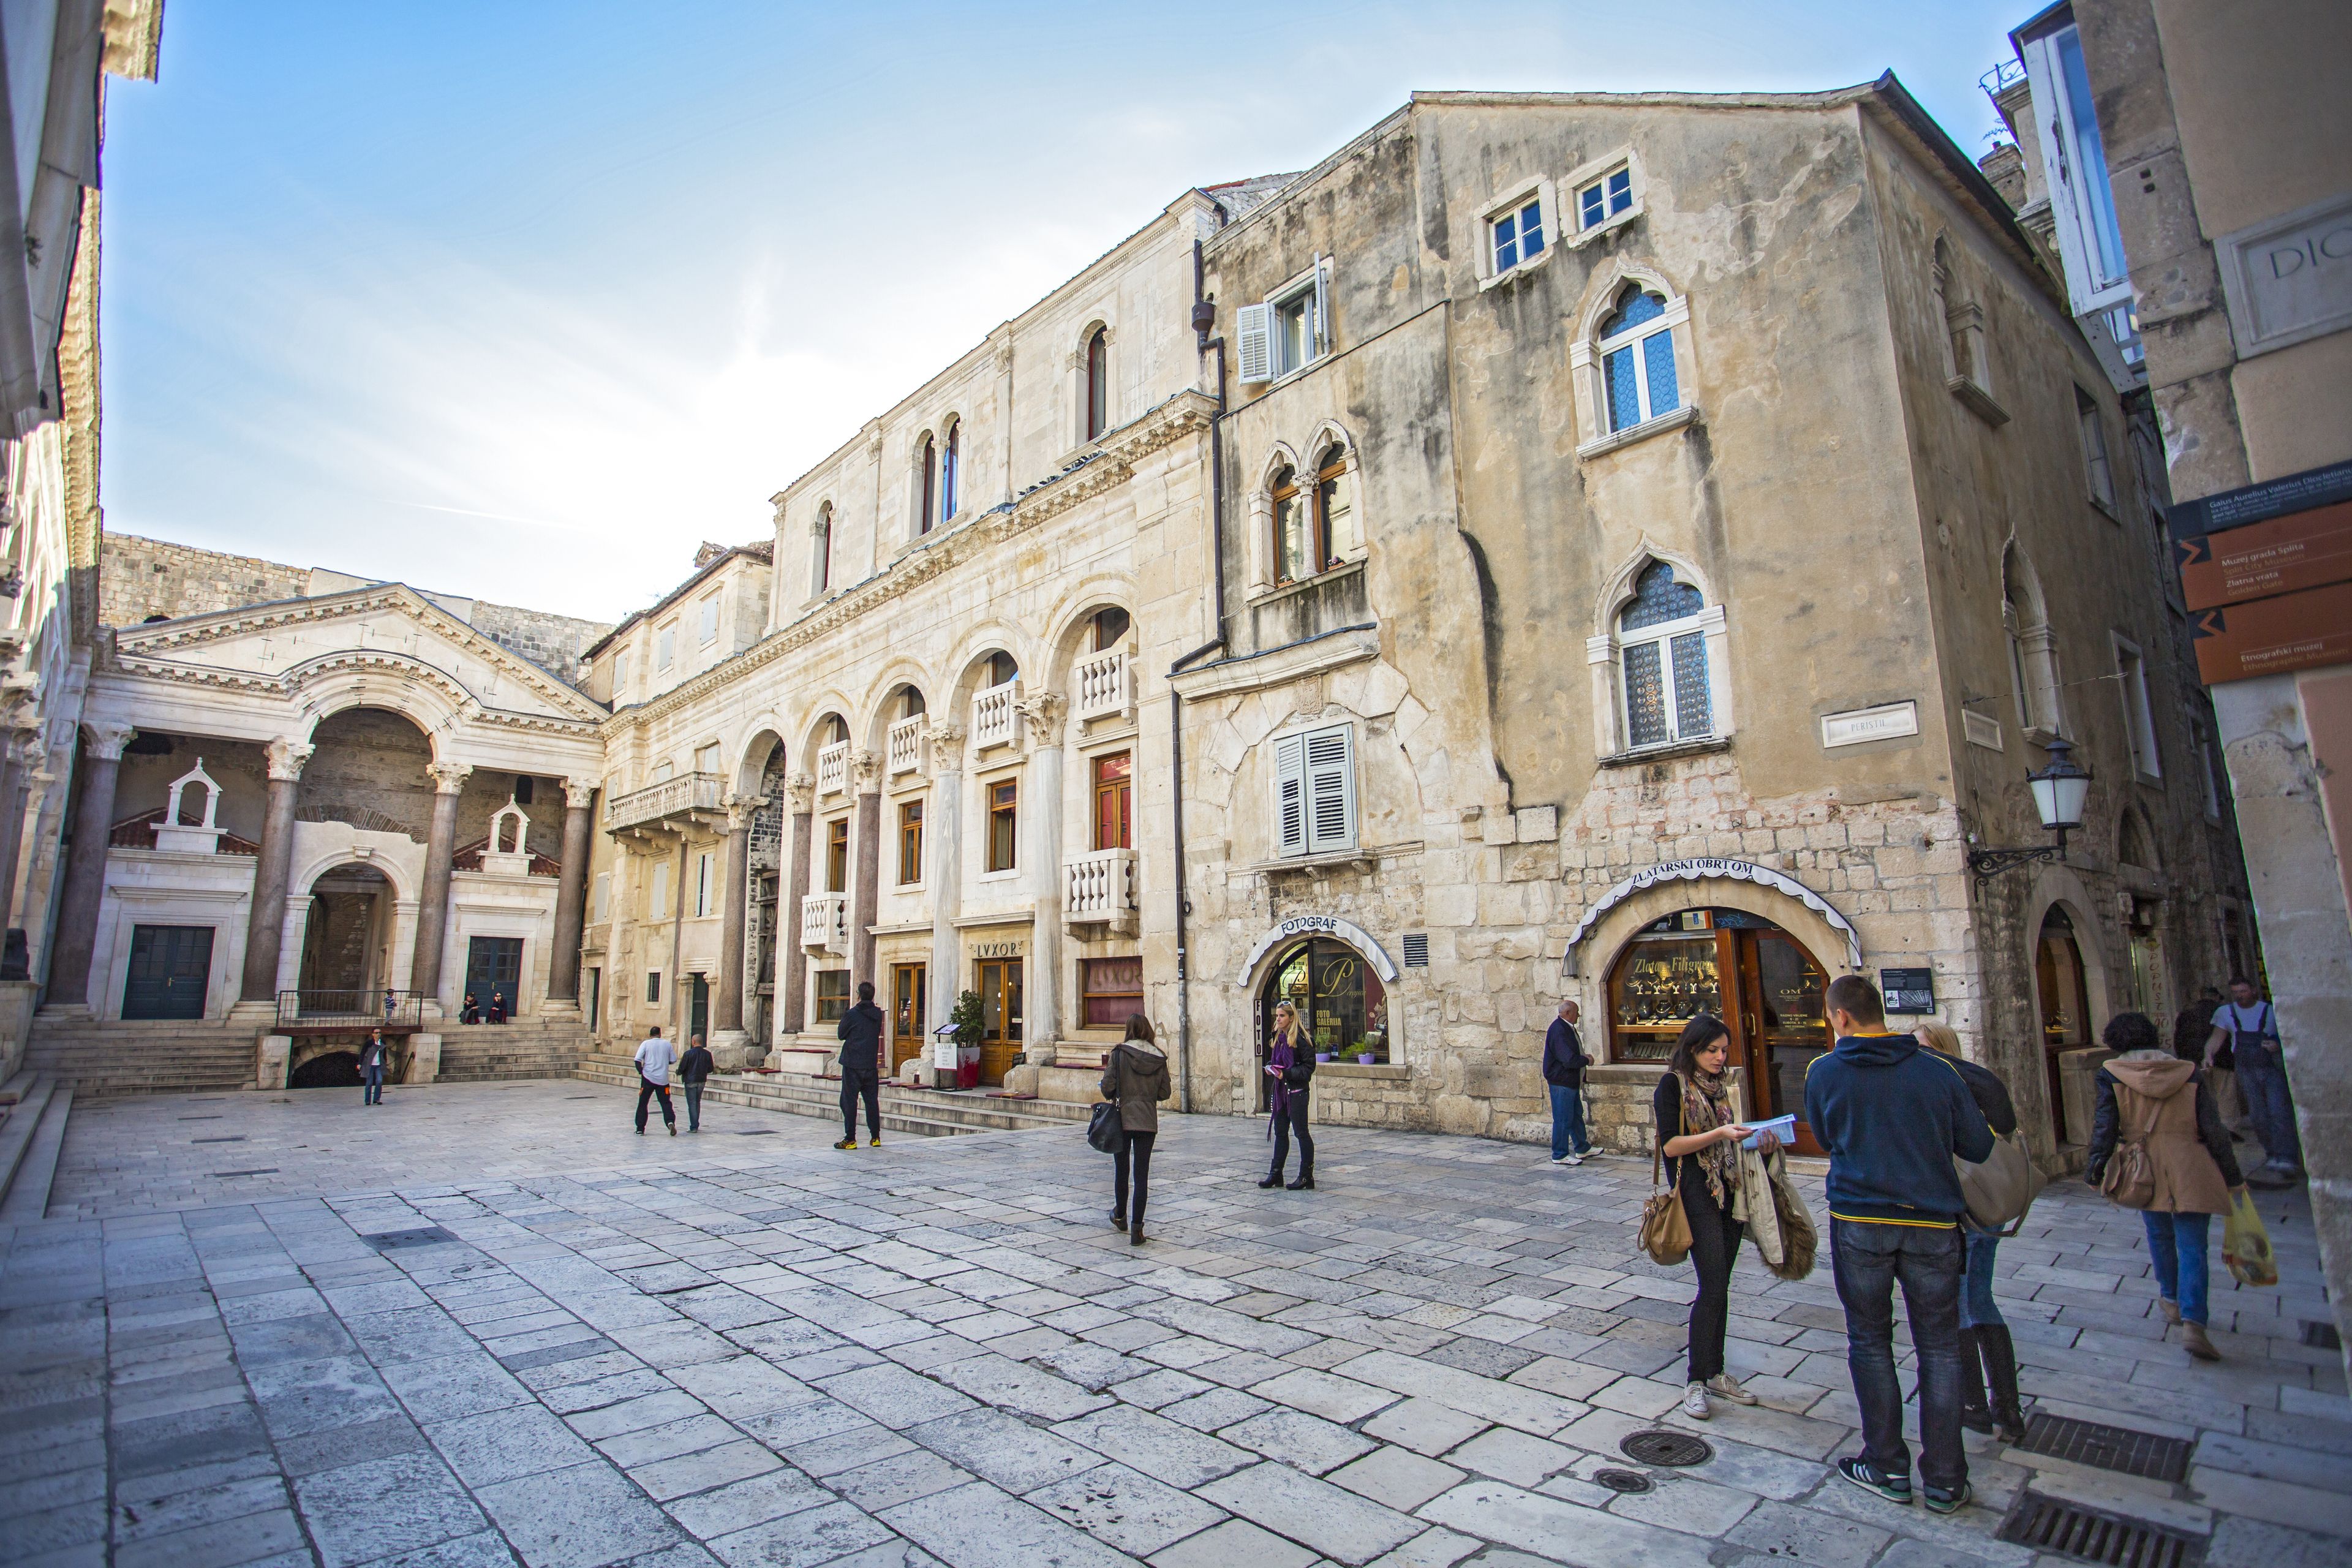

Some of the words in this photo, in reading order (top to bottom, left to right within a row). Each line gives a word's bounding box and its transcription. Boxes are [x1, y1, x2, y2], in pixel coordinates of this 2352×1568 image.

[2209, 499, 2233, 508] Gaius
[2234, 489, 2267, 502] Aurelius
[2268, 481, 2301, 495] Valerius
[2222, 557, 2248, 567] Muzej
[2250, 550, 2276, 562] grada
[2277, 543, 2304, 555] Splita
[2223, 566, 2243, 576] Split
[2245, 562, 2263, 571] City
[2226, 577, 2253, 587] Zlatna
[2255, 571, 2278, 581] vrata
[2228, 585, 2260, 596] Golden
[2262, 580, 2283, 589] Gate
[2241, 647, 2291, 662] Etnografski
[2294, 642, 2323, 653] muzej
[2242, 656, 2304, 671] Ethnographic
[2306, 649, 2349, 661] Museum
[1631, 860, 1694, 884] ZLATARSKI
[1697, 859, 1730, 869] OBRT
[1732, 861, 1754, 874] OM
[1281, 916, 1337, 933] FOTOGRAF
